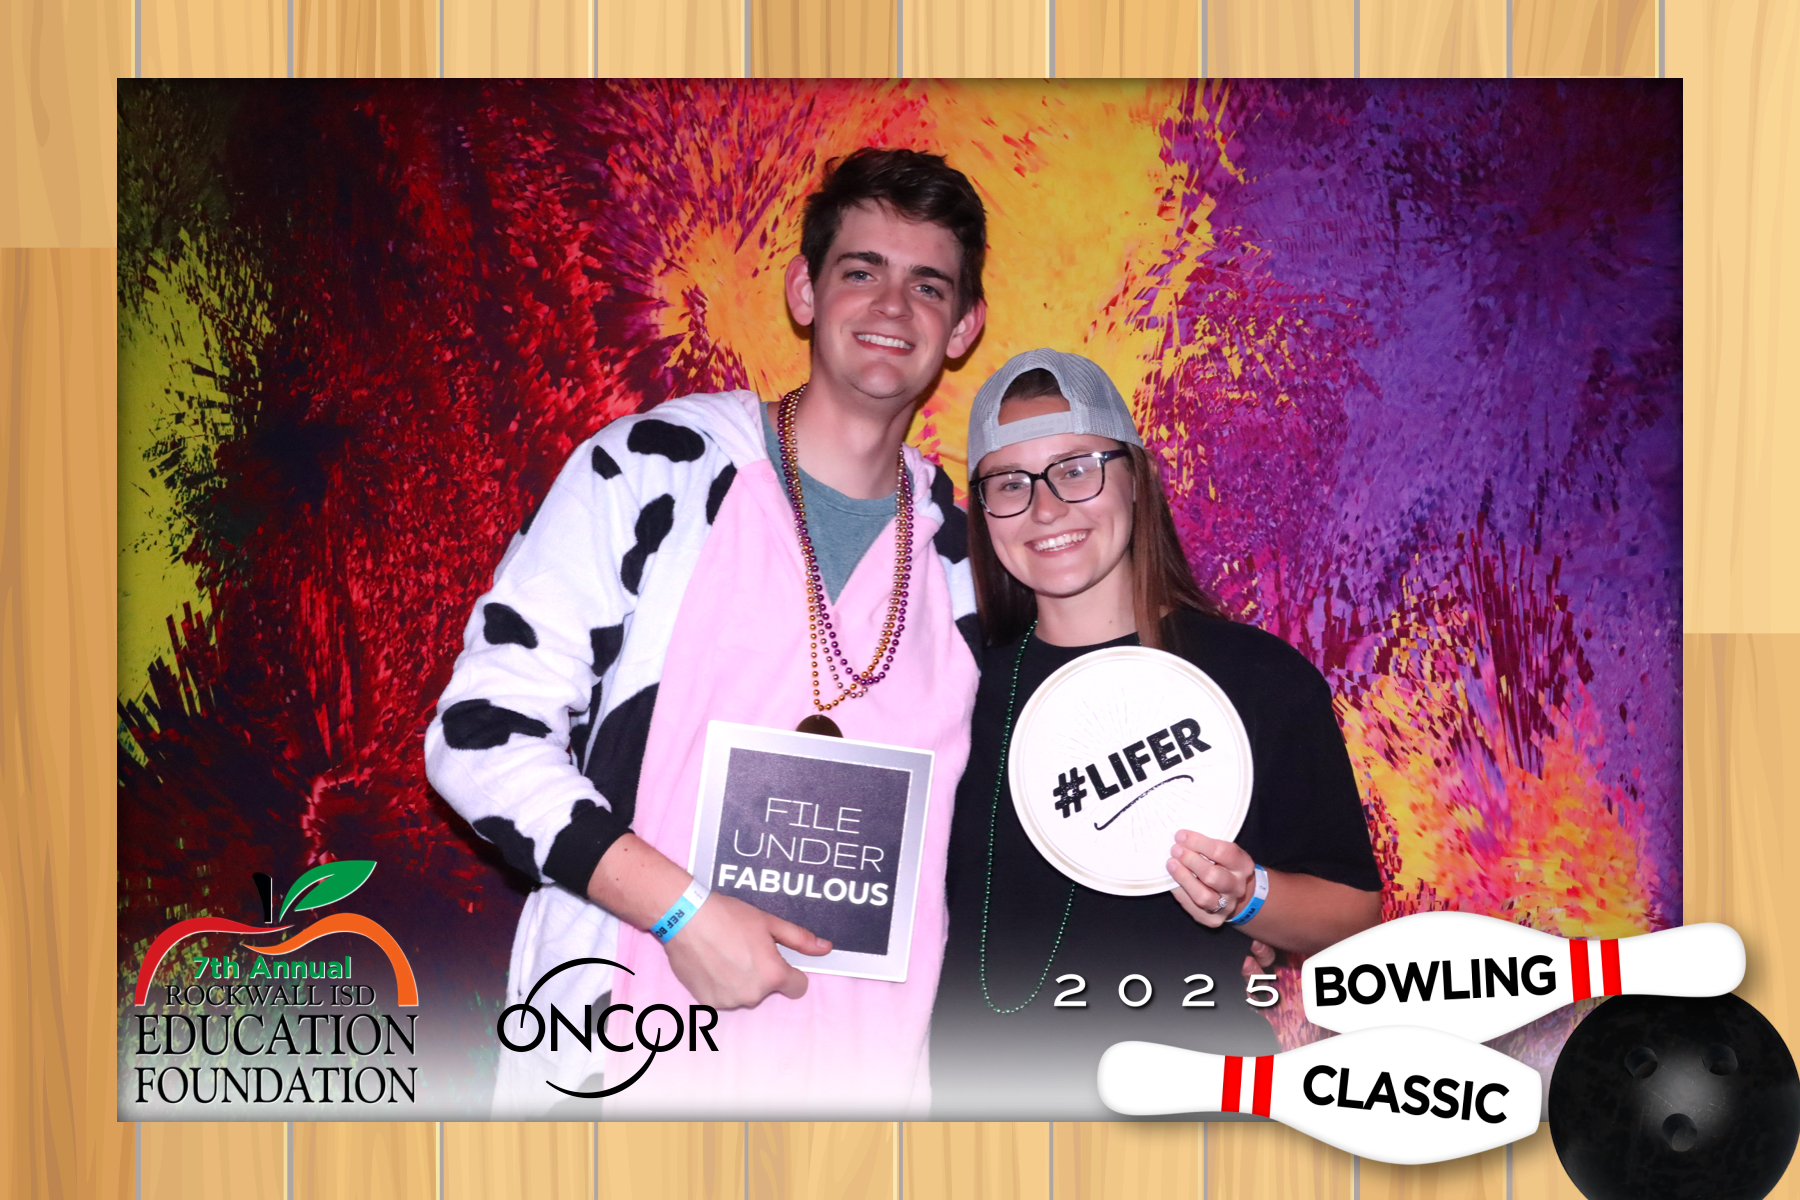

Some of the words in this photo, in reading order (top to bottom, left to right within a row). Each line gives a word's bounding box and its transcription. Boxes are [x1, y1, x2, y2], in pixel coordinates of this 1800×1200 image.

[1053, 717, 1212, 818] #LIFER
[765, 797, 862, 834] FILE
[734, 829, 884, 872] UNDER
[718, 864, 889, 906] FABULOUS
[667, 909, 685, 929] REF
